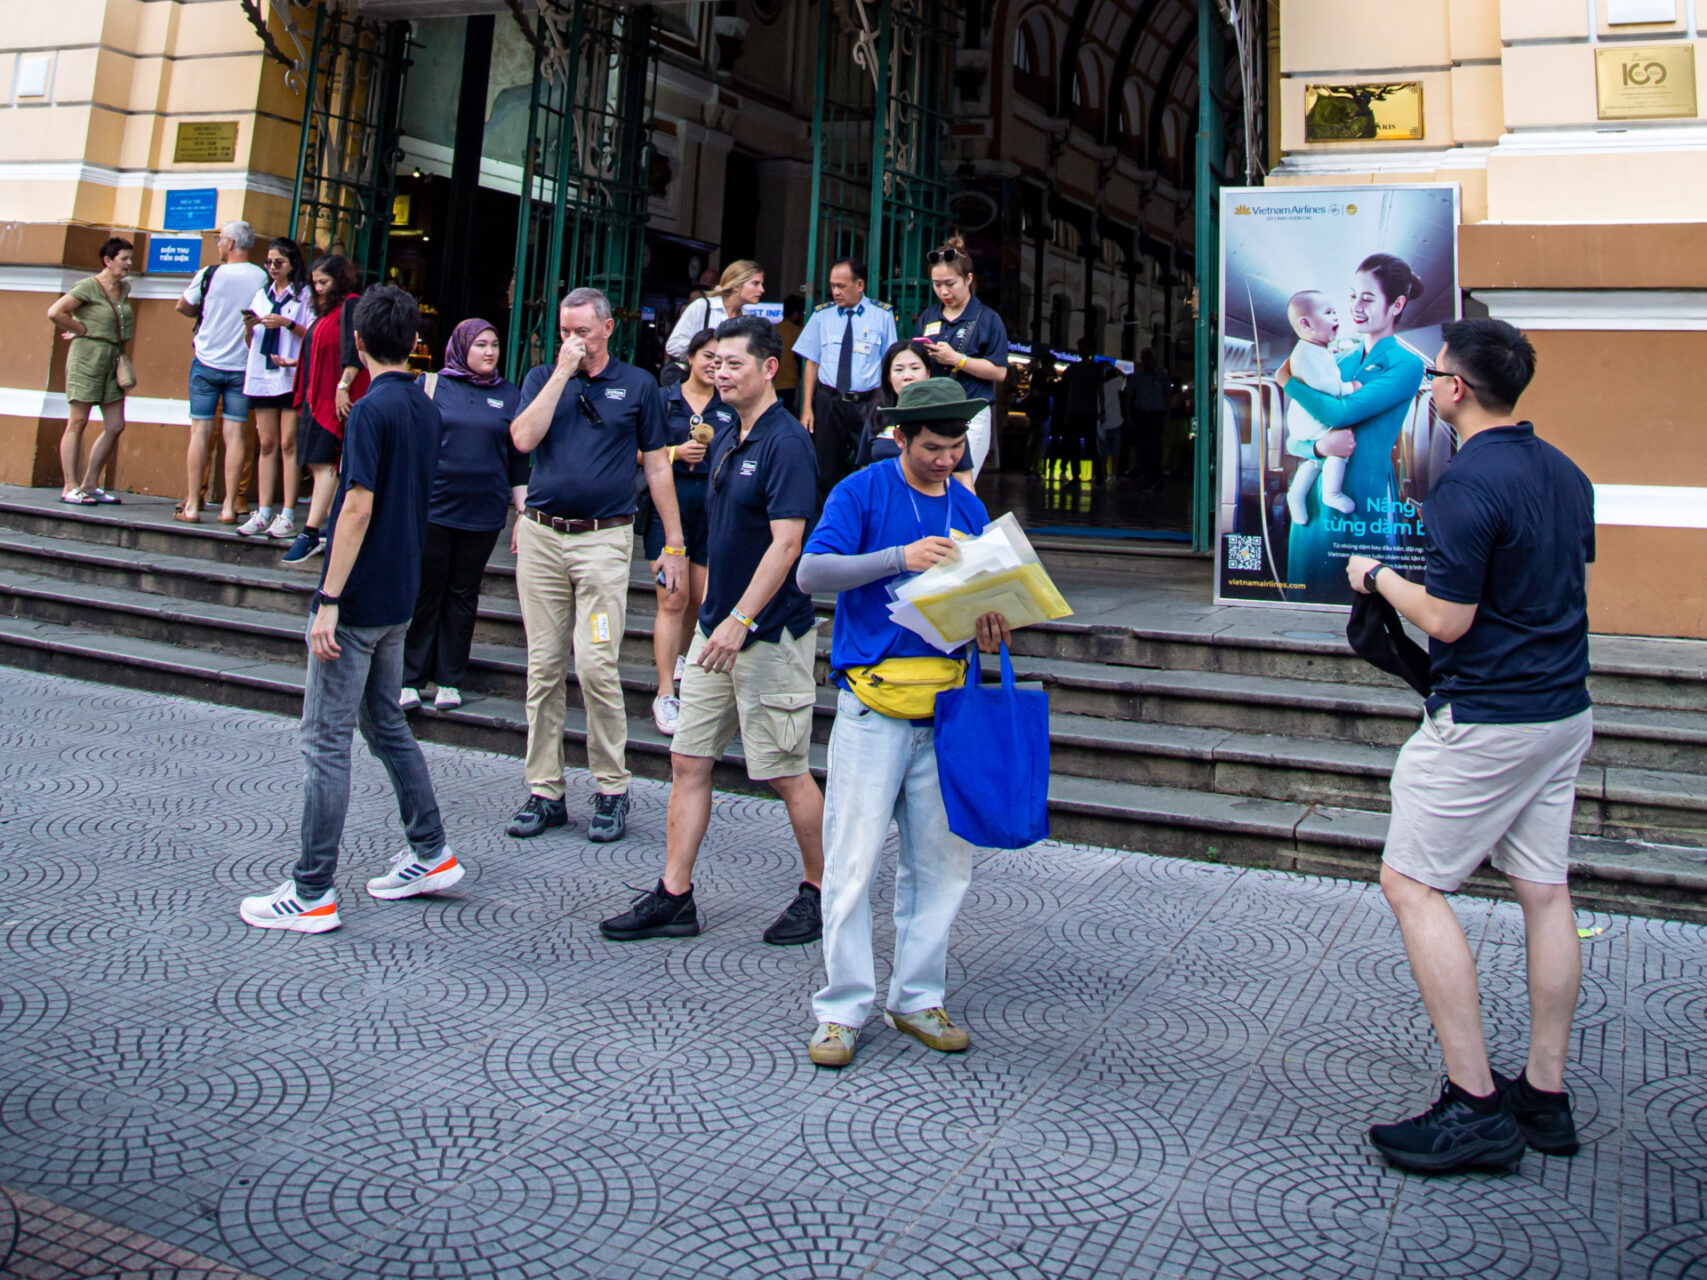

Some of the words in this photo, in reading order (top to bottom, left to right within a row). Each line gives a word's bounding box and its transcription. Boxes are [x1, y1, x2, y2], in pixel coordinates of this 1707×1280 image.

[766, 309, 784, 317] INF
[1366, 496, 1416, 517] Nâng
[1323, 516, 1366, 537] từng
[1370, 518, 1412, 538] dặm
[1416, 519, 1425, 536] b
[1228, 578, 1306, 590] vietnamairlines.com
